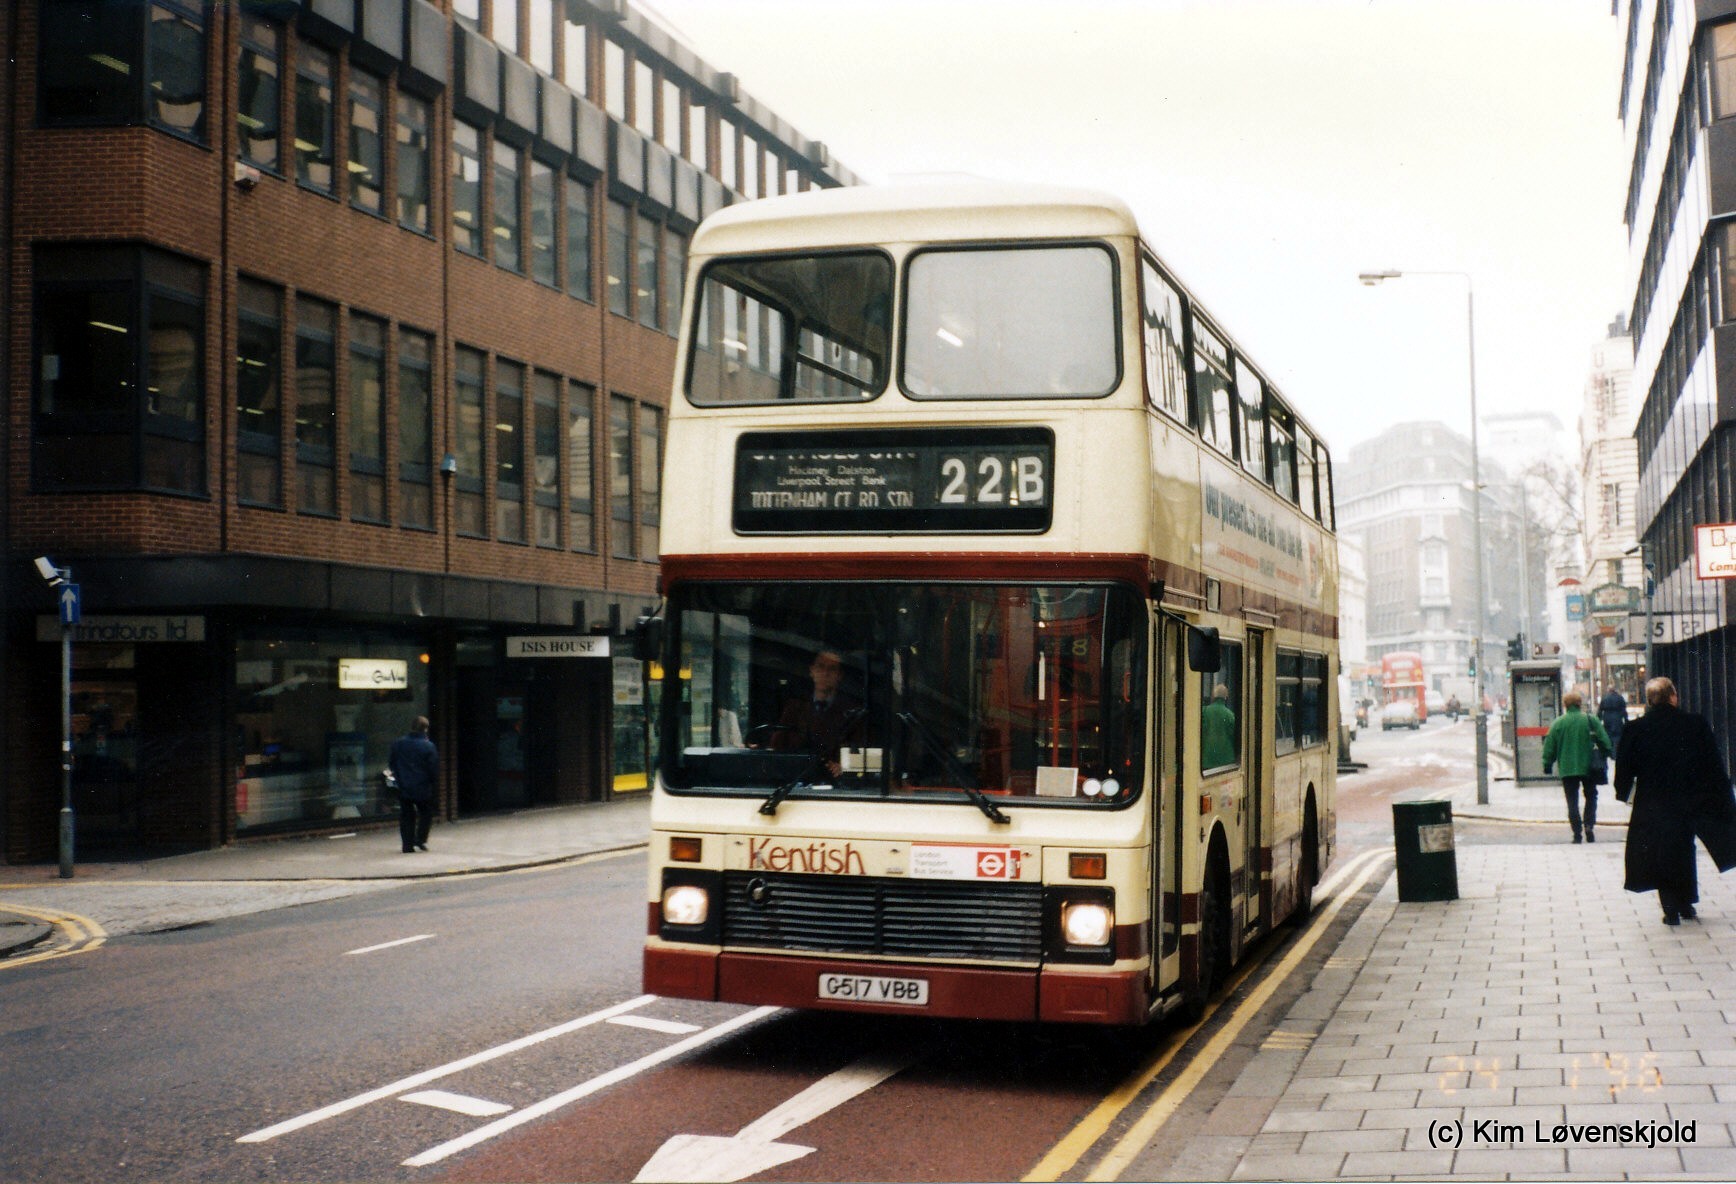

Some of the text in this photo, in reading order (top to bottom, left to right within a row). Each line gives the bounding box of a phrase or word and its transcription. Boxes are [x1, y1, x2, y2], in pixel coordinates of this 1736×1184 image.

[825, 476, 855, 486] Street
[862, 475, 886, 486] Bank
[522, 641, 595, 653] ISIS HOUSE
[749, 837, 866, 876] Kentish
[826, 977, 920, 1000] G517 VBB
